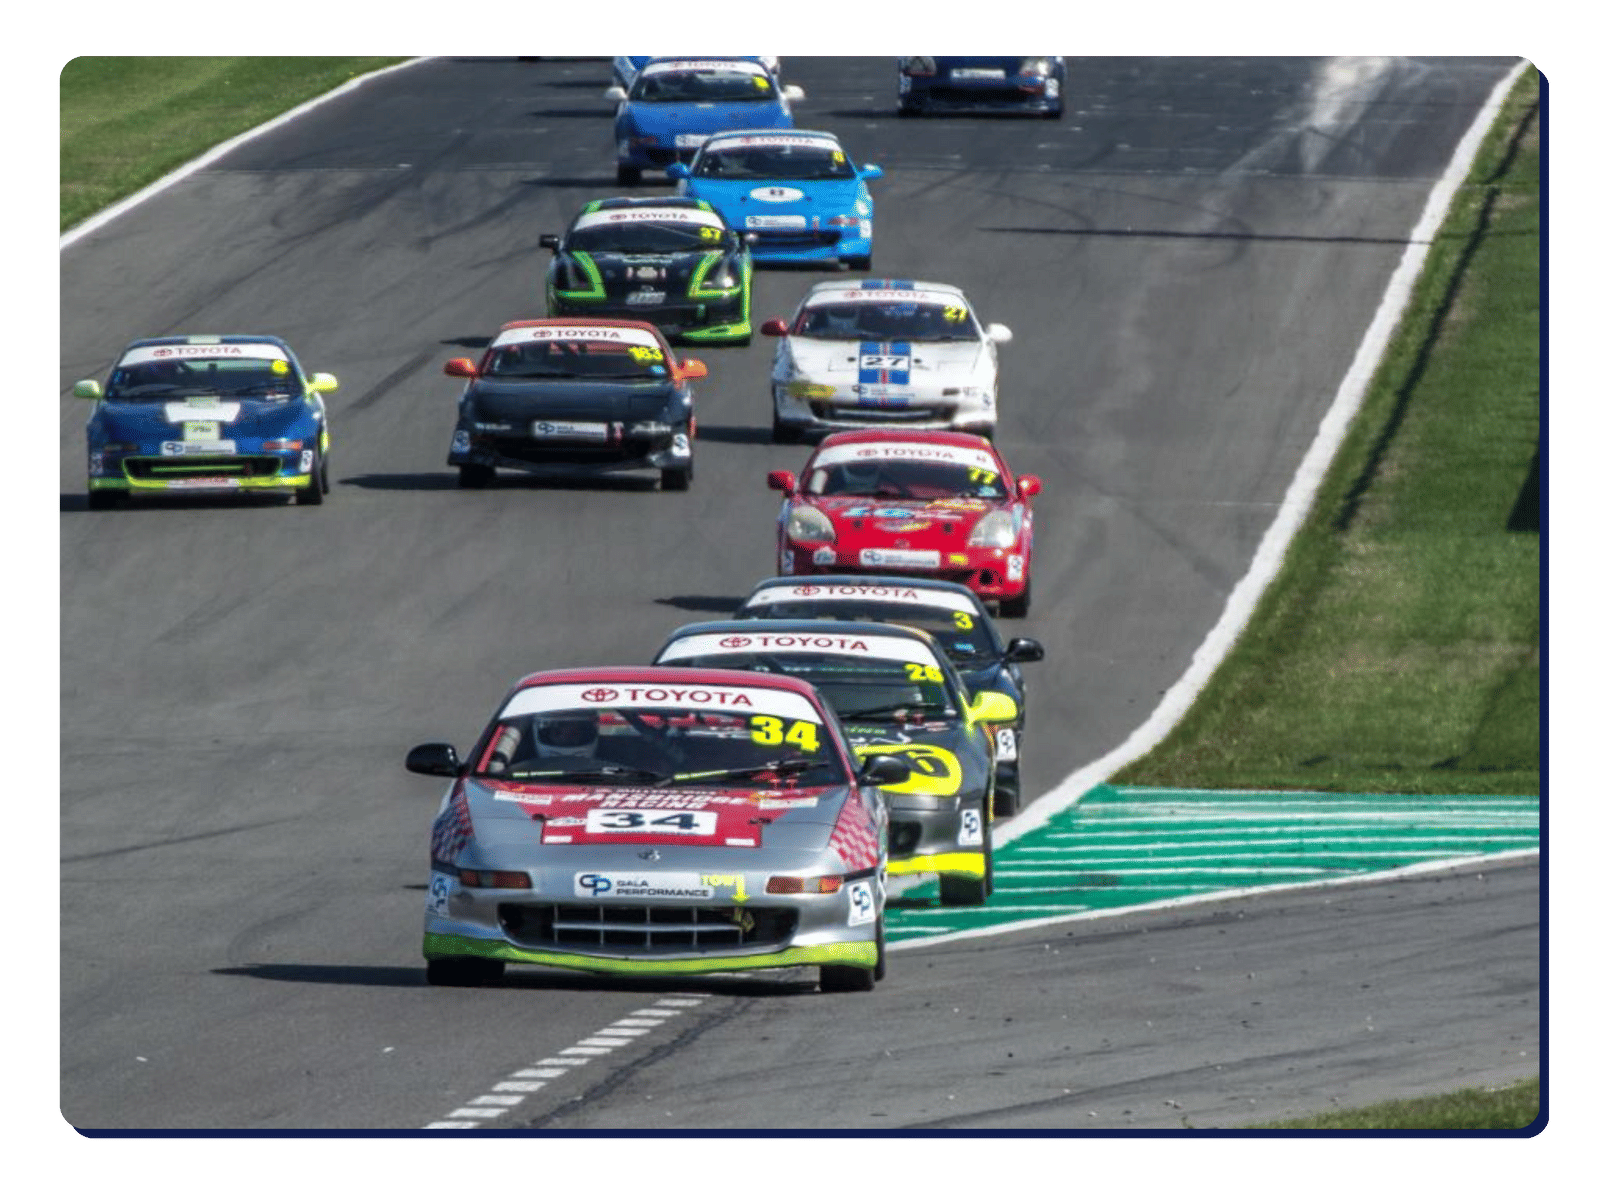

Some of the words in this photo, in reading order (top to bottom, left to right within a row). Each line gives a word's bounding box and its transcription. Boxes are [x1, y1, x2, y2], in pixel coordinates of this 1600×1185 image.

[631, 212, 688, 220] TOYOTA
[943, 304, 967, 322] 27
[556, 329, 620, 339] TOYOTA
[177, 346, 243, 356] TOYOTA
[866, 357, 904, 367] 27
[882, 448, 953, 459] TOYOTA
[968, 466, 997, 484] 77
[827, 585, 918, 600] TOYOTA
[953, 611, 974, 630] 3
[756, 636, 869, 652] TOYOTA
[622, 689, 752, 707] TOYOTA
[751, 713, 820, 752] 34
[600, 800, 708, 809] RACING
[600, 812, 700, 830] 34
[616, 880, 648, 888] GALA
[616, 888, 709, 898] PERFORMANCE
